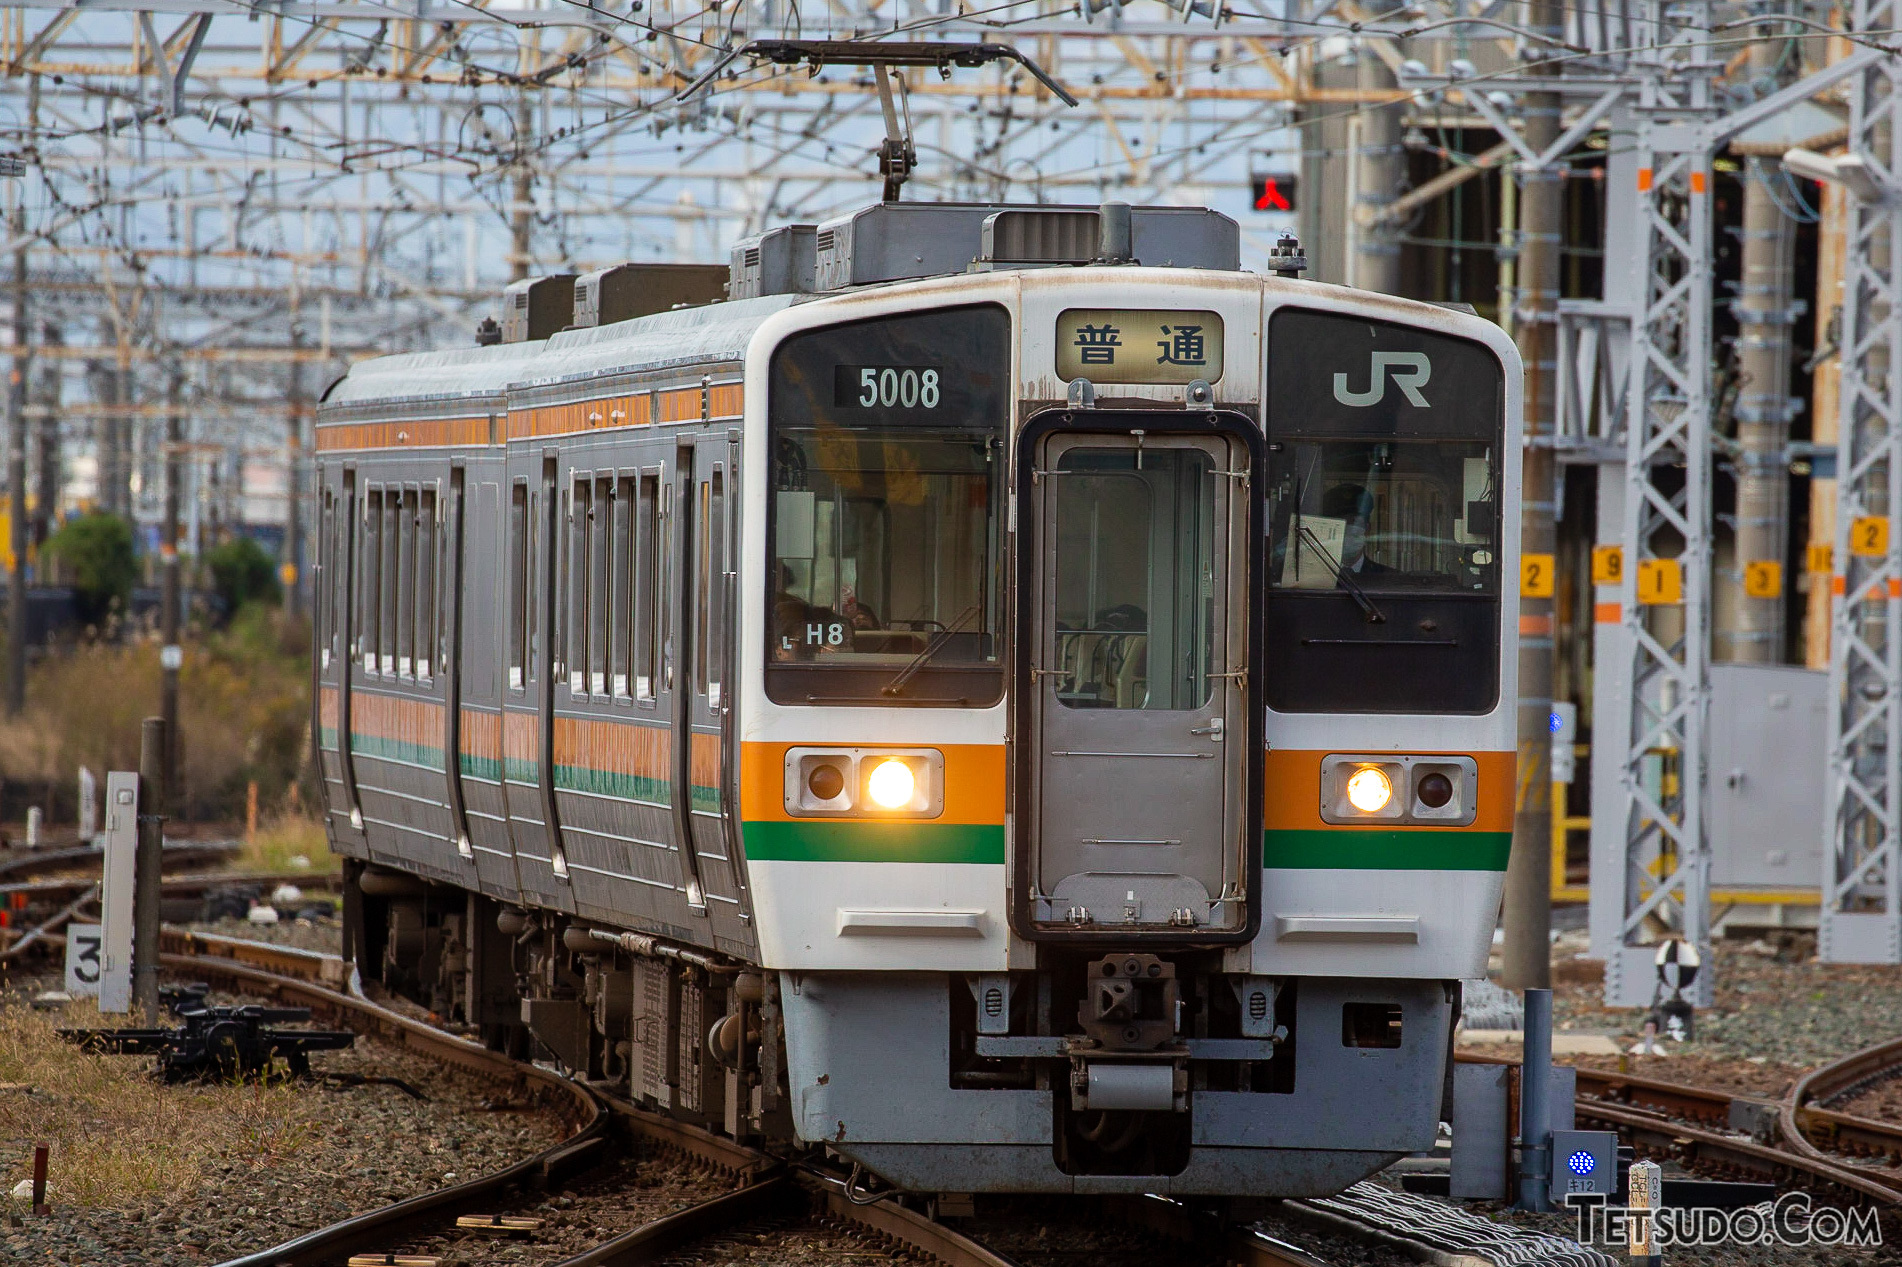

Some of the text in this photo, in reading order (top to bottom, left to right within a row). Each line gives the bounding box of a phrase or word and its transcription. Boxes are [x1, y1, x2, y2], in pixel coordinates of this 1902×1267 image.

[1074, 324, 1206, 366] 普通
[859, 368, 940, 408] 5008
[1333, 351, 1432, 407] JR
[1865, 524, 1879, 548] 2
[1526, 563, 1541, 588] 2
[1607, 552, 1621, 577] 9
[1756, 568, 1770, 592] 3
[806, 623, 844, 646] H8
